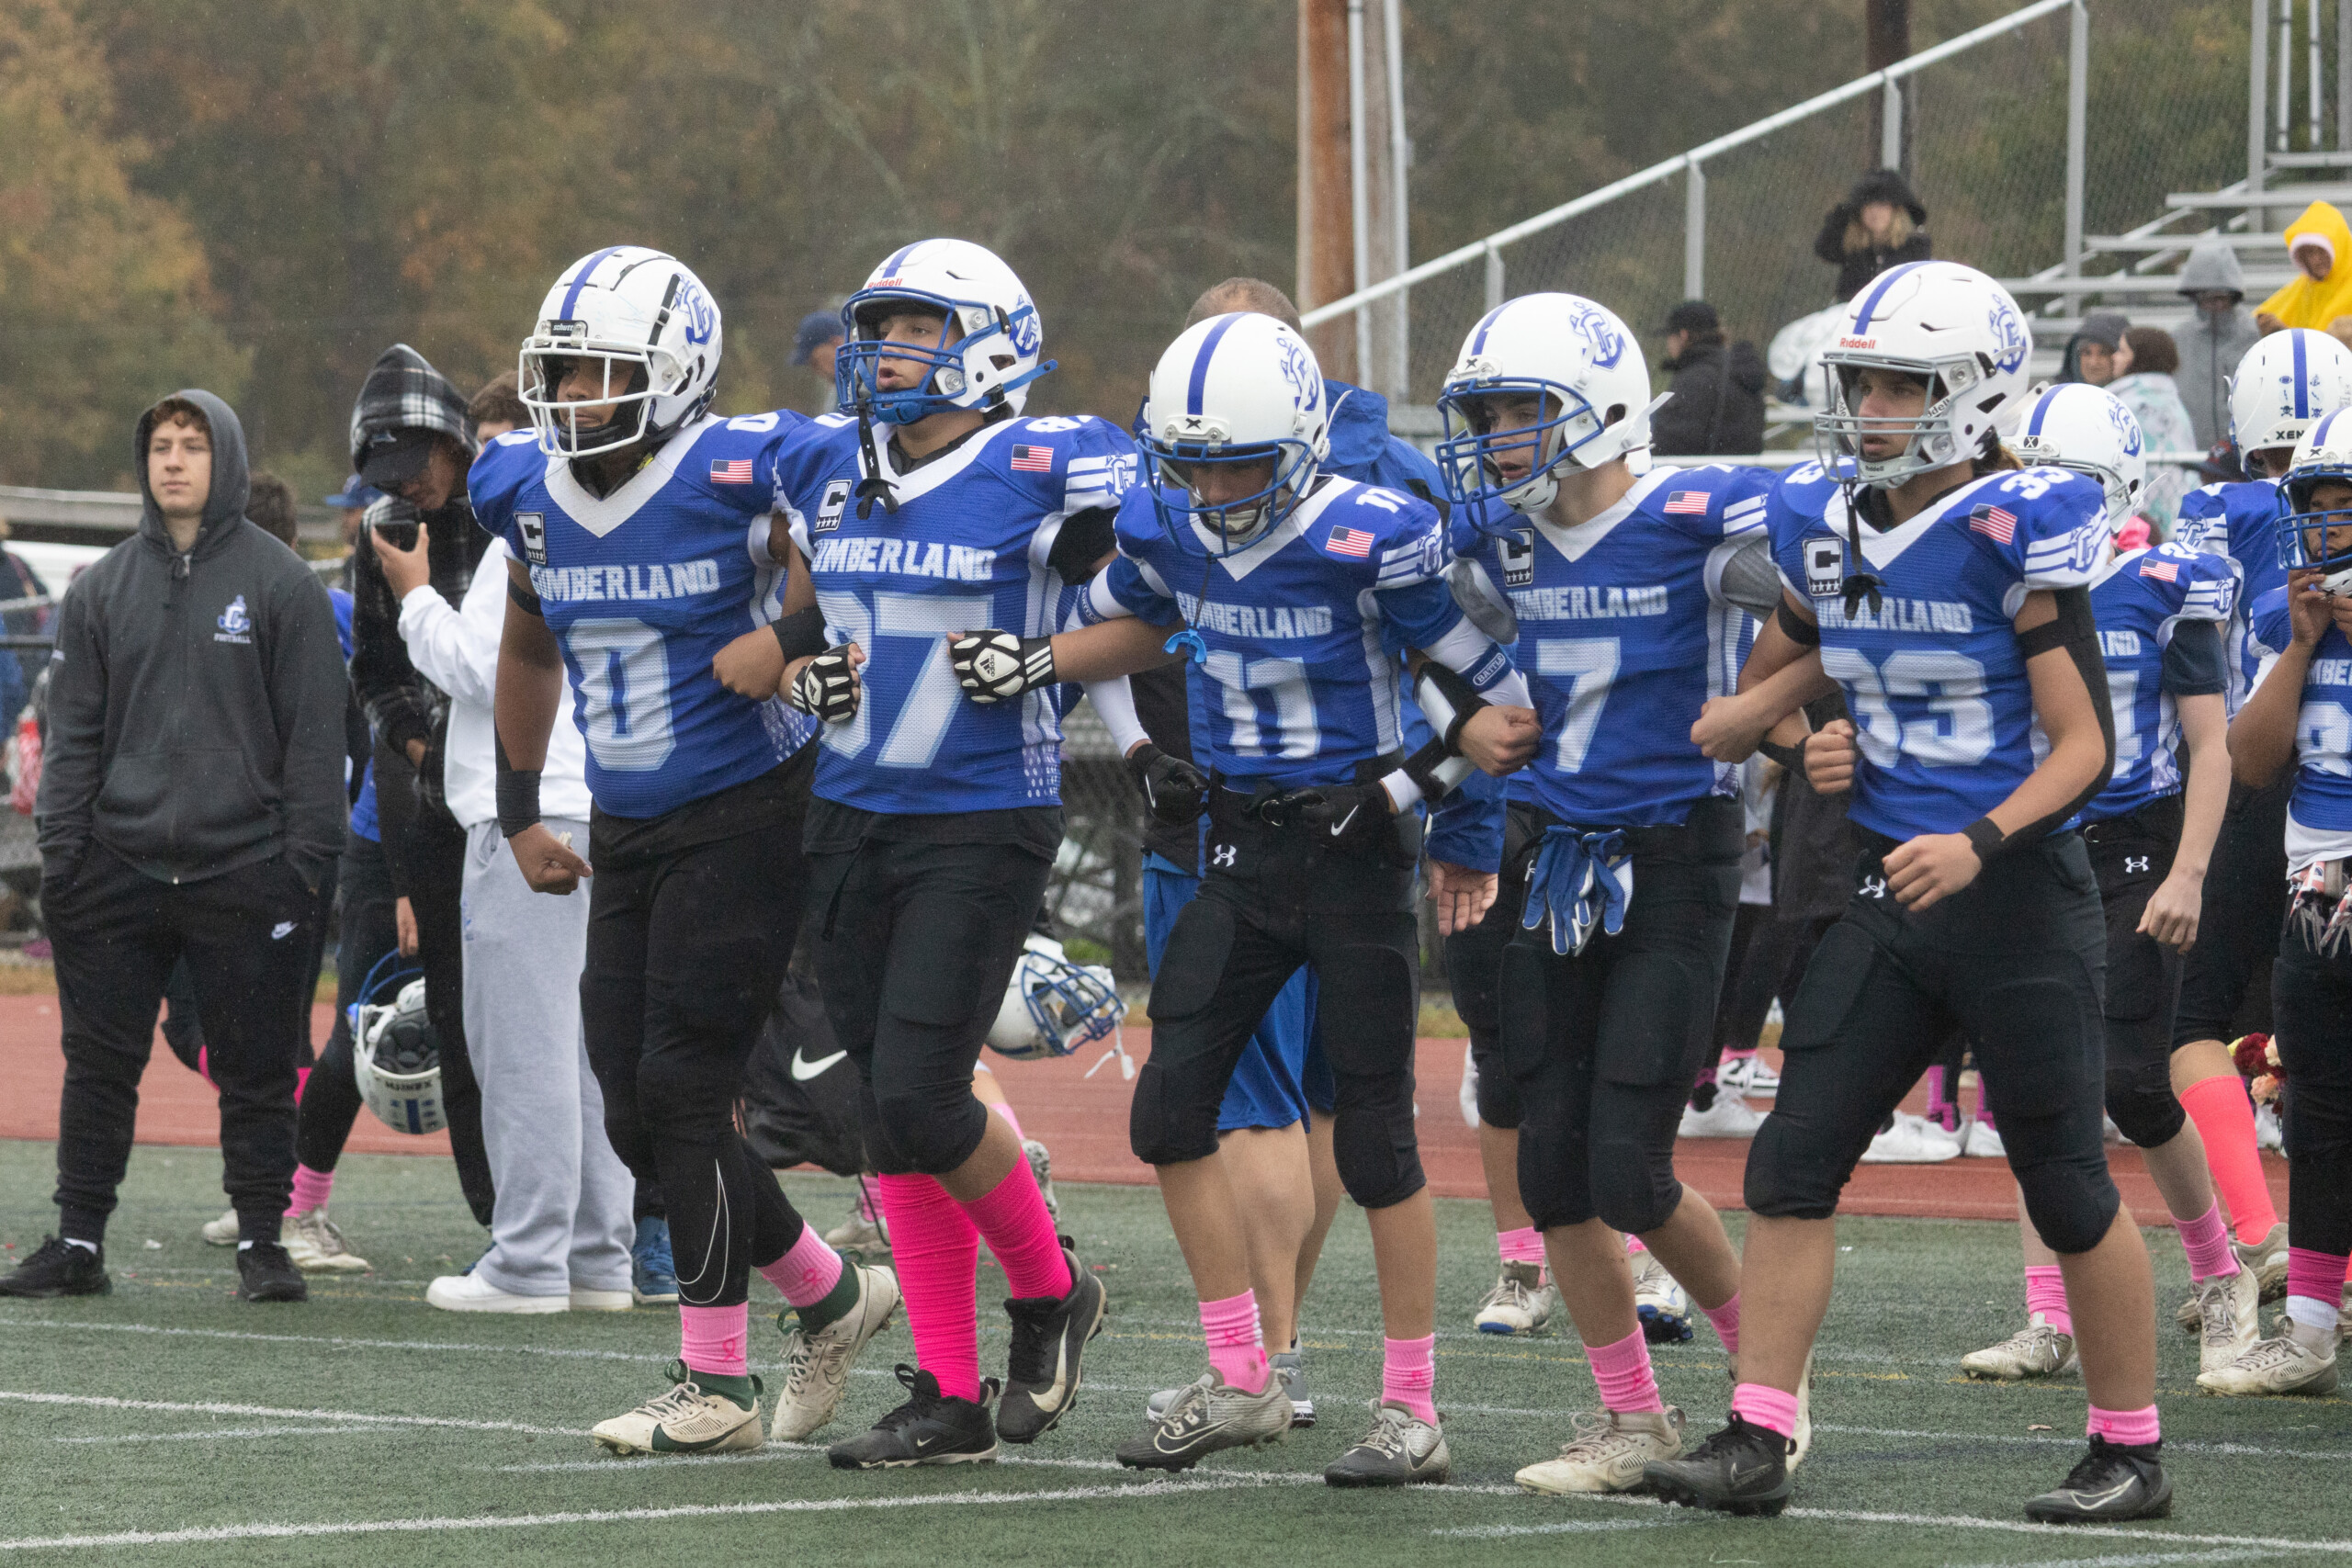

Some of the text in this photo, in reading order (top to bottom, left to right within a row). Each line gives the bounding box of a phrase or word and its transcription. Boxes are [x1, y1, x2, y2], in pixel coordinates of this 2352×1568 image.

[1839, 337, 1876, 349] Riddell
[820, 482, 849, 517] C
[517, 515, 542, 550] C
[1498, 531, 1532, 570] C
[1806, 541, 1840, 581] C
[1476, 655, 1503, 682] BATTLE
[566, 617, 676, 772] 0
[1202, 649, 1322, 761] 11
[1536, 637, 1622, 773] 7
